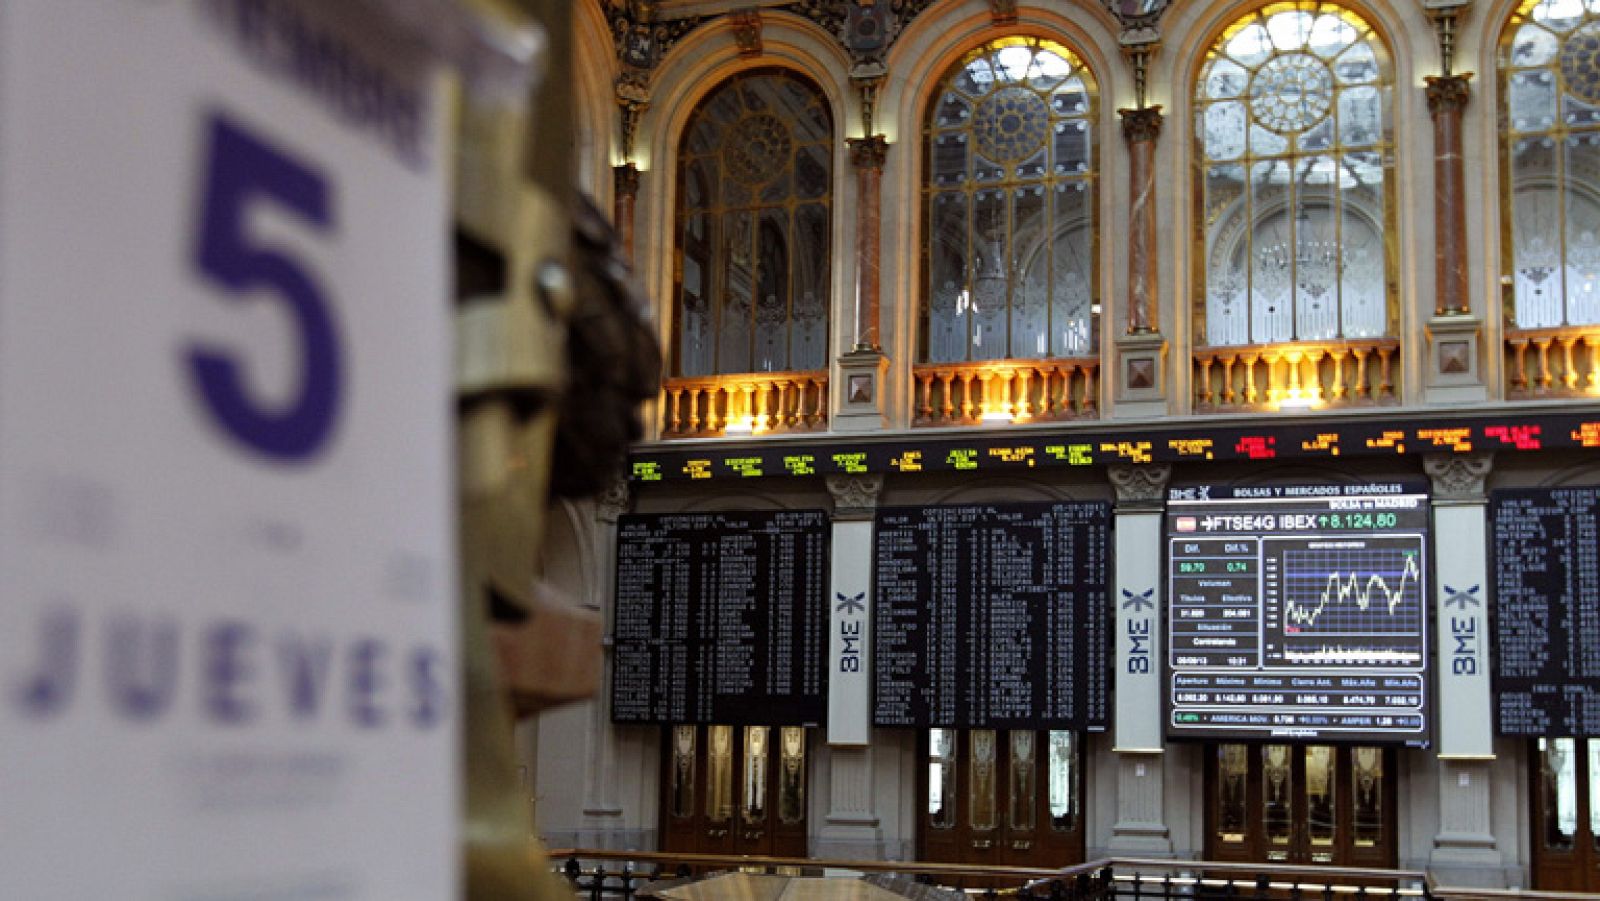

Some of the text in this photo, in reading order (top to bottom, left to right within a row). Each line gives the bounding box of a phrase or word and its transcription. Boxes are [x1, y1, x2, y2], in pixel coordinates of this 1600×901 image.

[184, 106, 346, 467] 5
[1233, 483, 1403, 497] BOLSAS Y MERCADOS ESPAÑOLES
[1279, 513, 1318, 530] IBEX
[14, 602, 443, 732] JUEVES
[841, 620, 859, 672] BME
[1128, 619, 1149, 674] BME
[1451, 616, 1475, 675] BME
